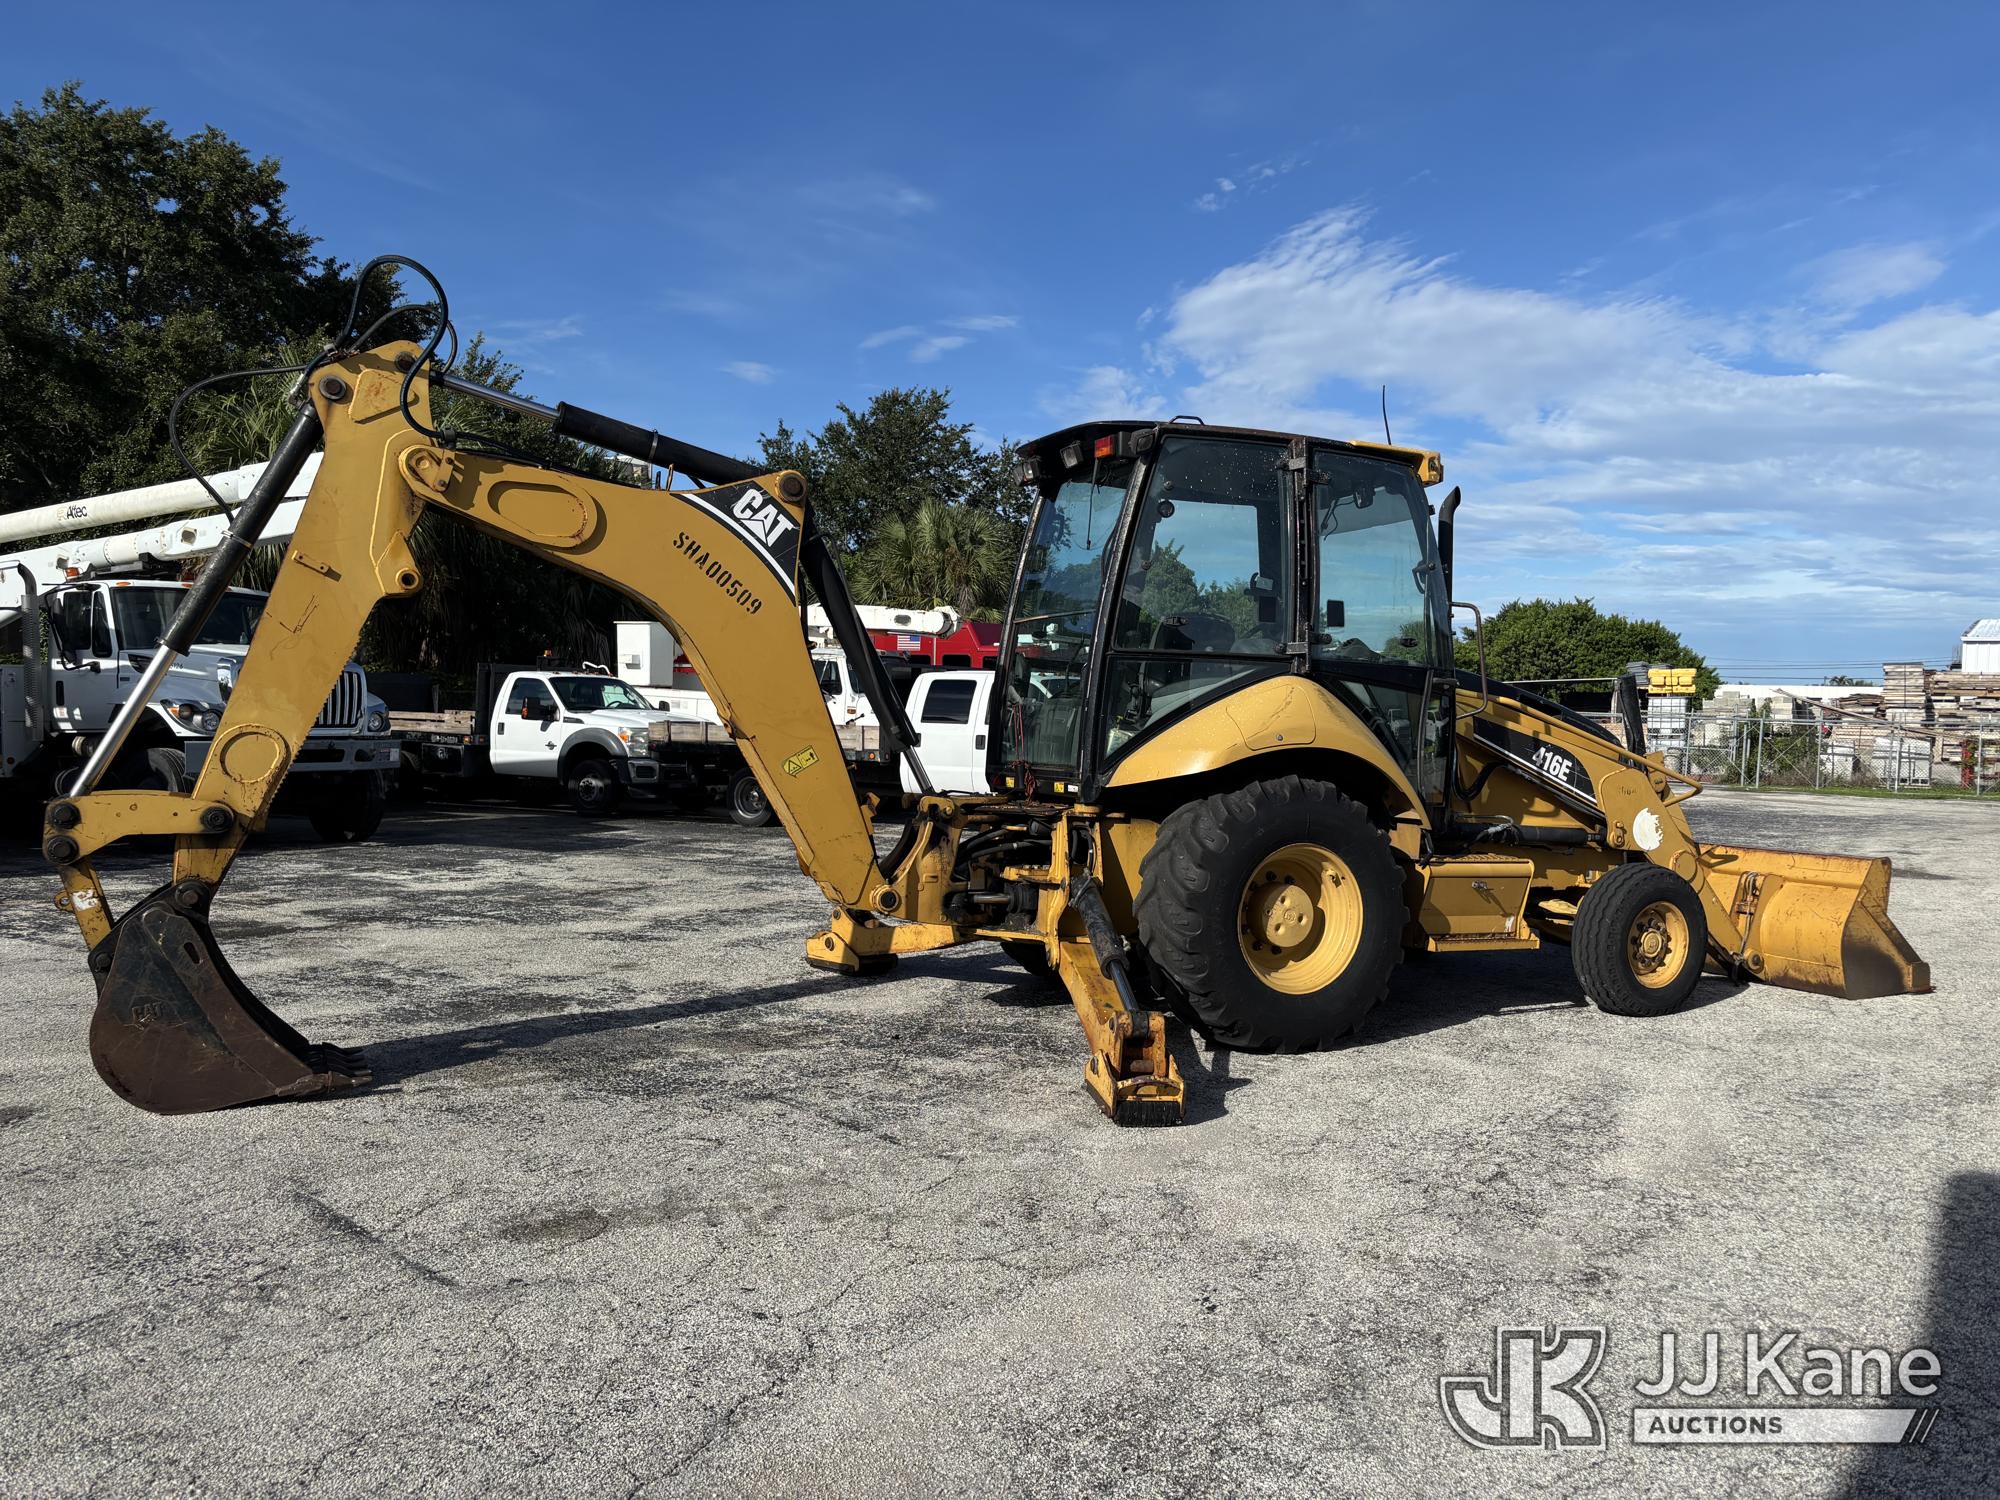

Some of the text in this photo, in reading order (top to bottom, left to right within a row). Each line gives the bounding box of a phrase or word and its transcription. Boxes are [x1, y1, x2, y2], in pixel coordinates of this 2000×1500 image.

[732, 488, 794, 547] CAT
[673, 531, 763, 614] SHA00509
[1532, 747, 1573, 782] 416E
